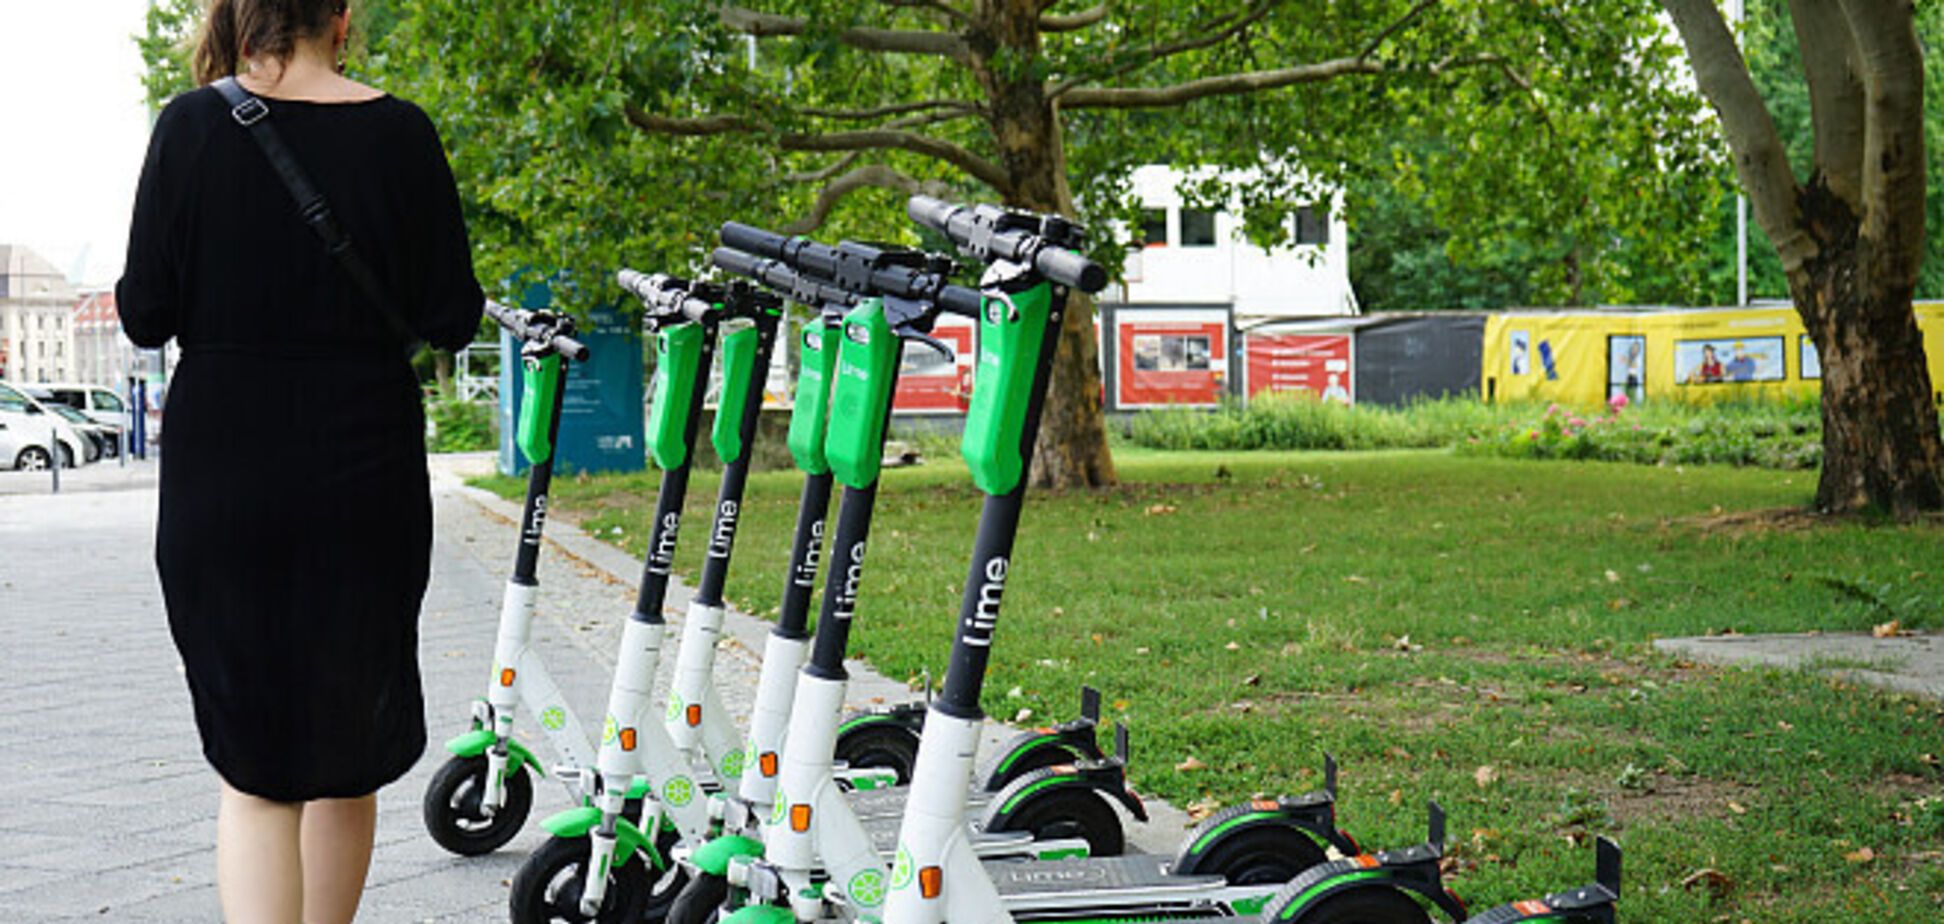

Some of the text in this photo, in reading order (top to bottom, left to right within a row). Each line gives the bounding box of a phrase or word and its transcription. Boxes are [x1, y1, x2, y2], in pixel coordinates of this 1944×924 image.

[649, 512, 679, 574] Lime
[708, 500, 737, 558] Lime
[795, 520, 825, 587] Lime
[834, 541, 866, 618] Lime
[962, 556, 1009, 646] Lime
